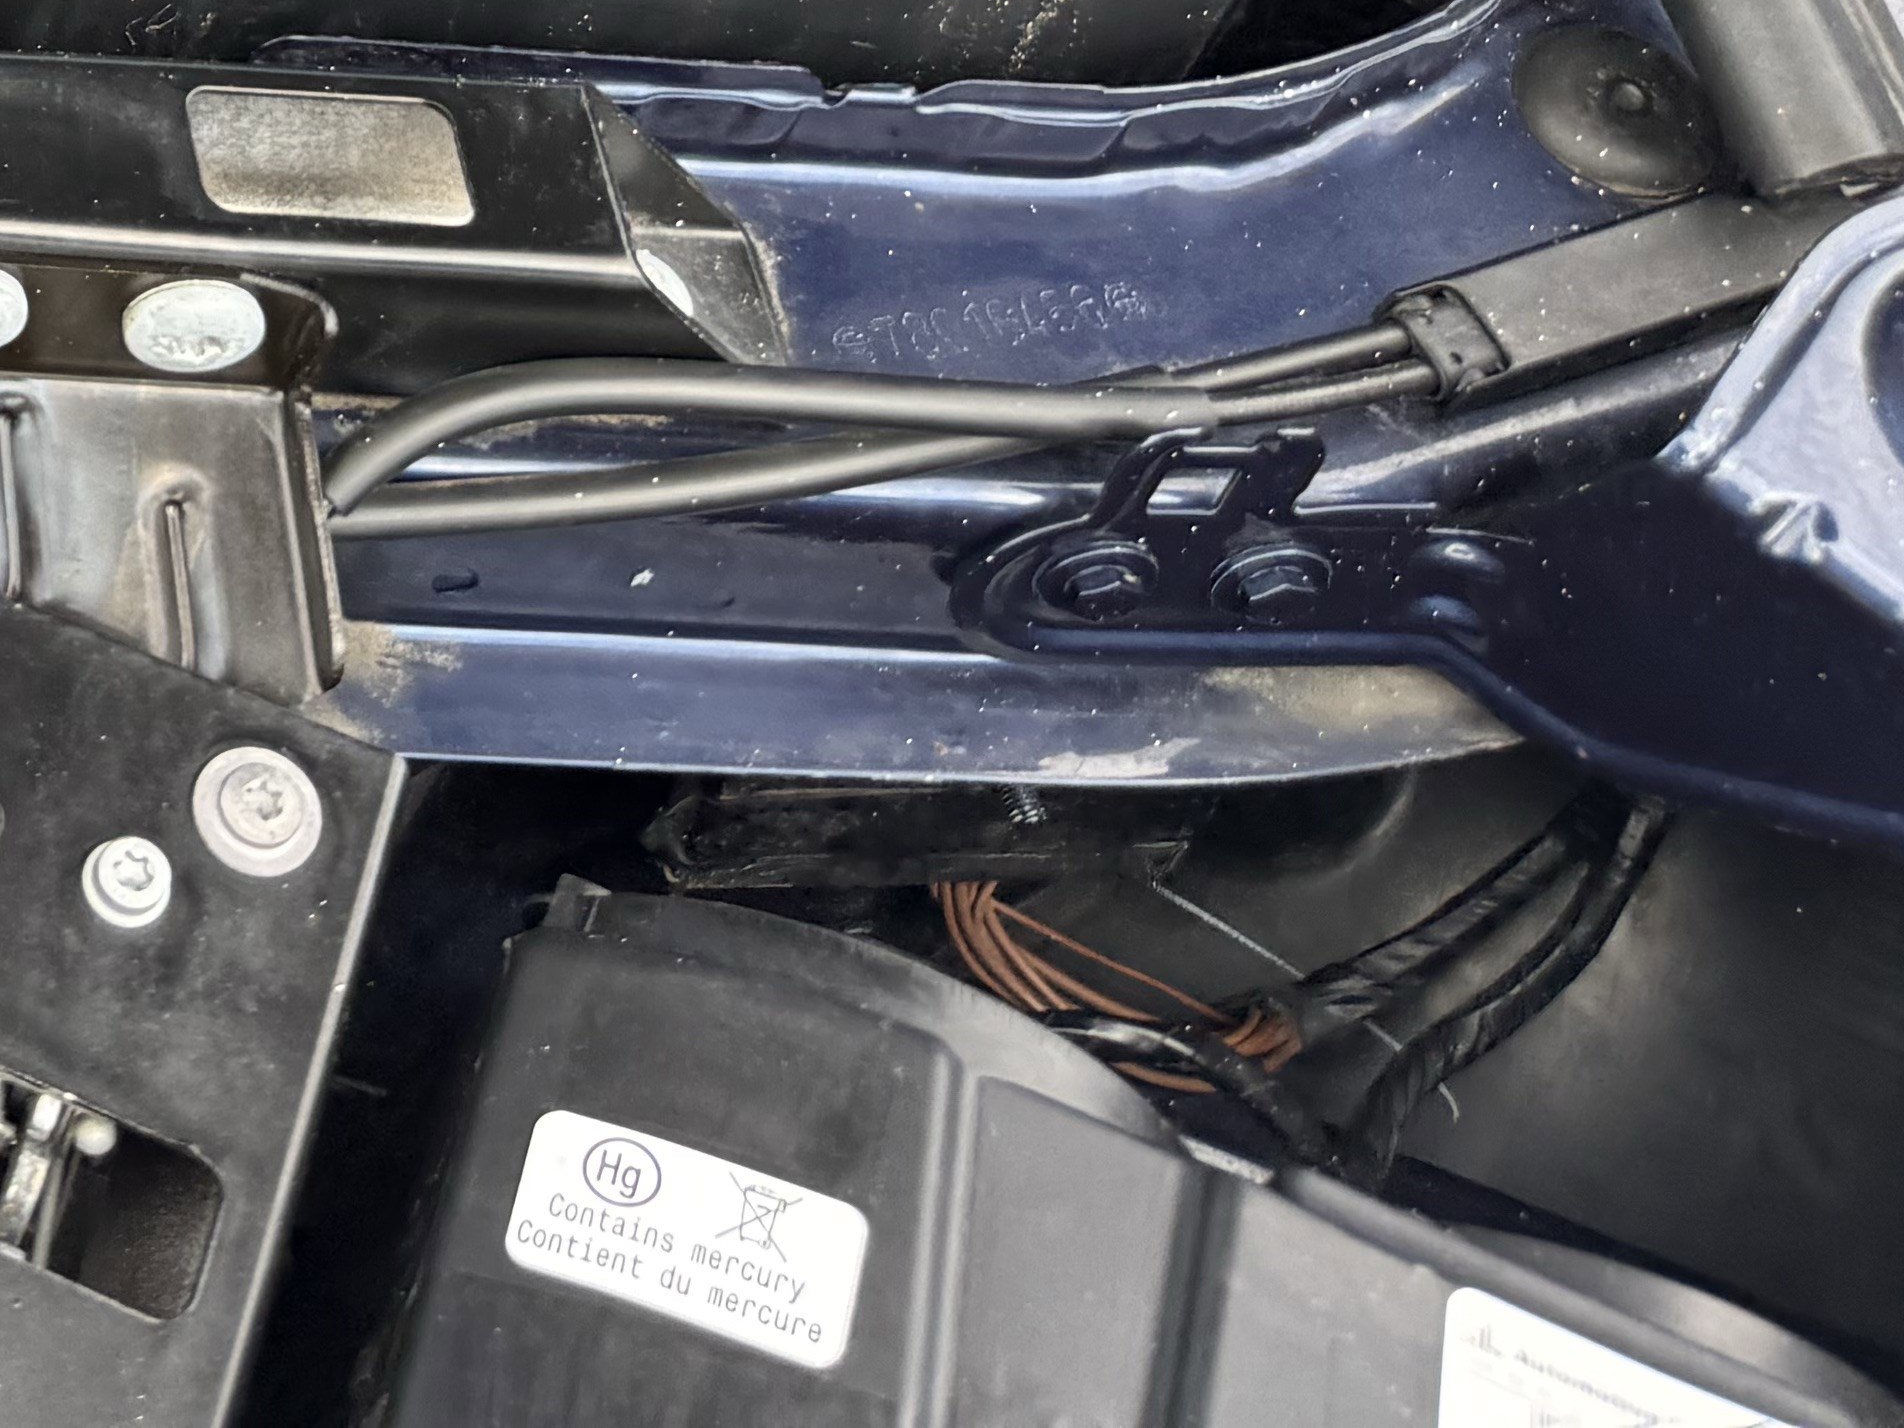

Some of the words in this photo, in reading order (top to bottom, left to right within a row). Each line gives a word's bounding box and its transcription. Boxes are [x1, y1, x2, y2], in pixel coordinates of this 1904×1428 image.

[595, 1148, 642, 1198] Hg
[517, 1218, 641, 1280] Contient
[659, 1265, 692, 1296] du
[707, 1286, 823, 1344] mercure
[548, 1192, 675, 1254] Contains
[690, 1242, 806, 1304] mercury
